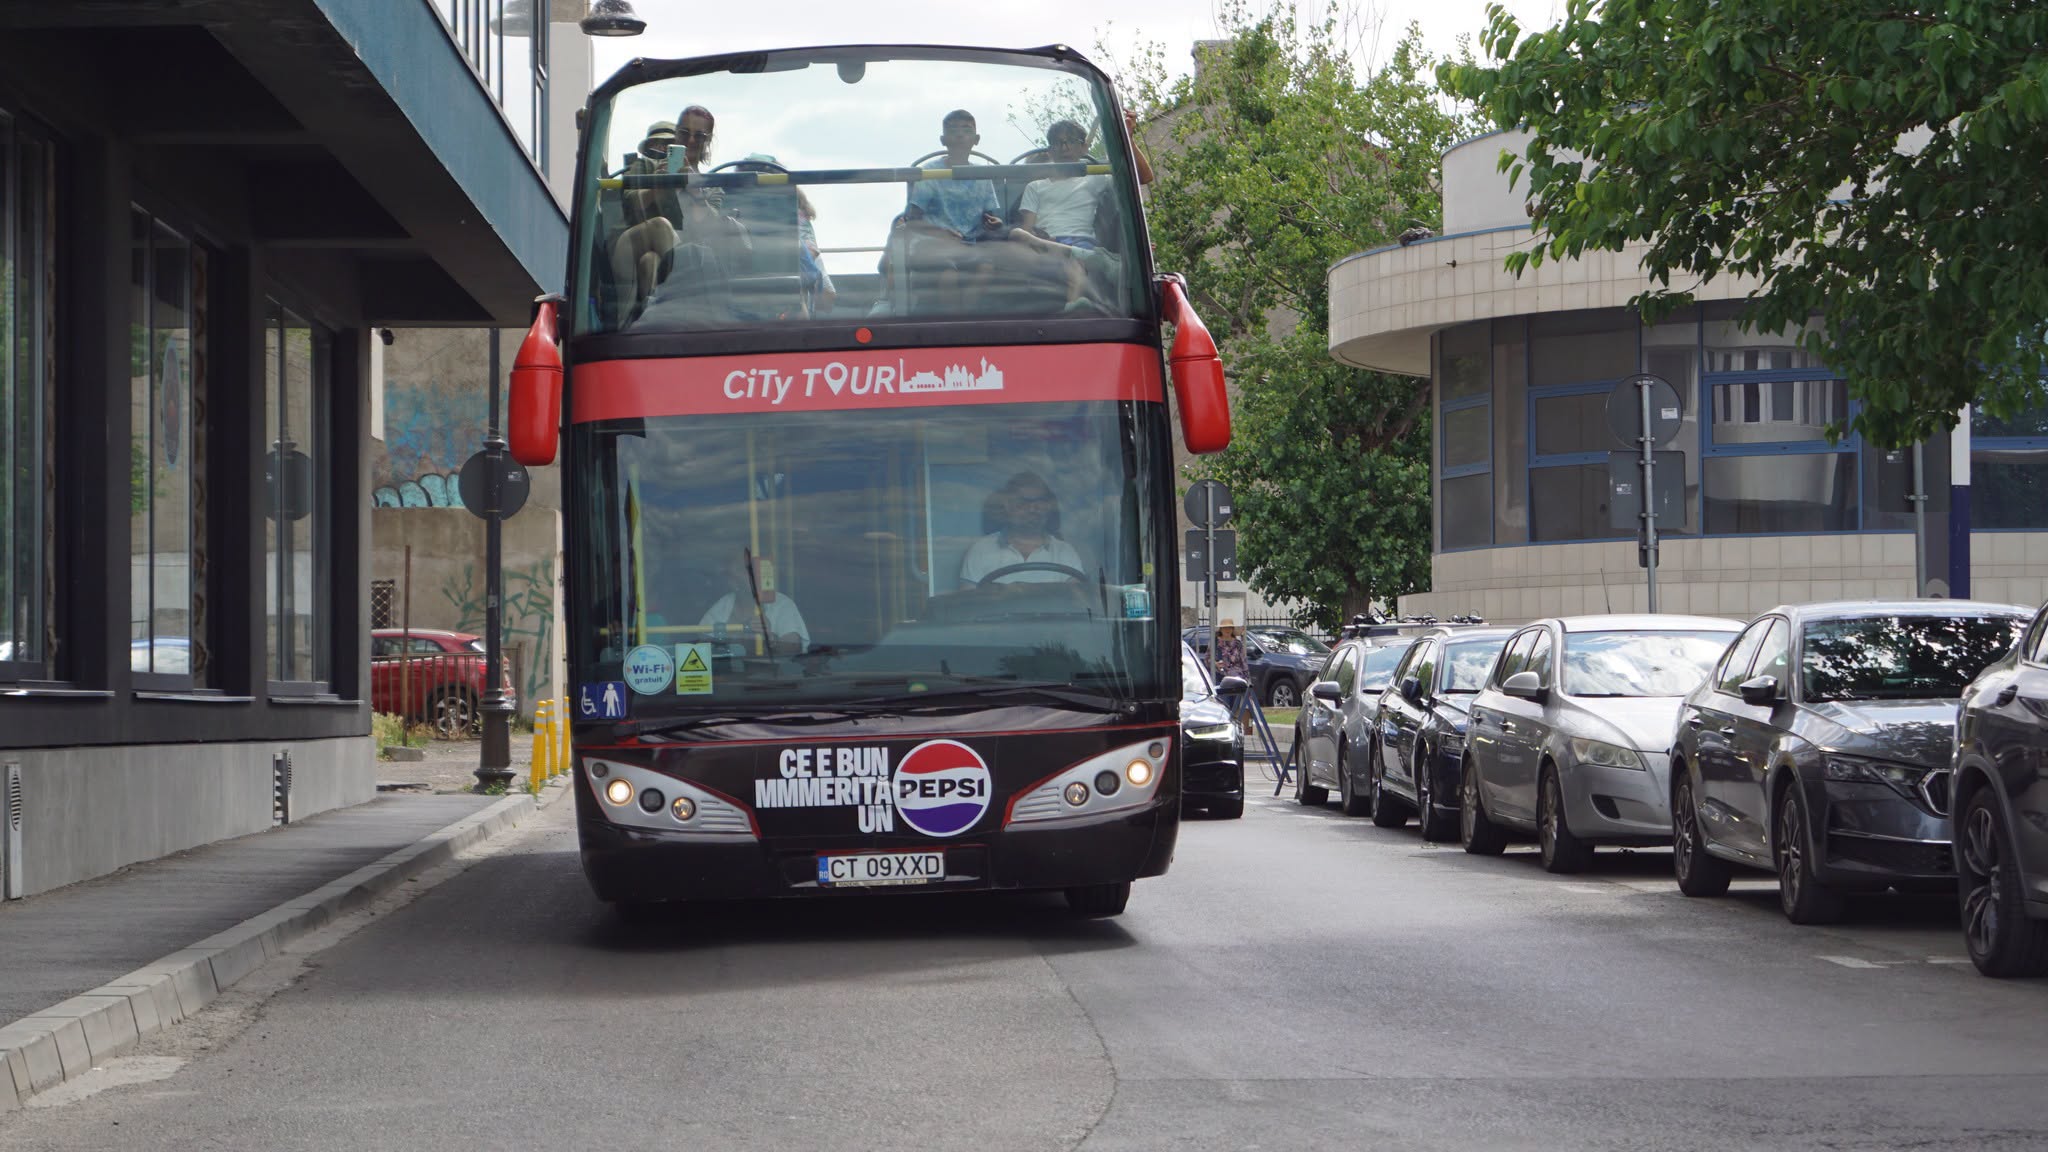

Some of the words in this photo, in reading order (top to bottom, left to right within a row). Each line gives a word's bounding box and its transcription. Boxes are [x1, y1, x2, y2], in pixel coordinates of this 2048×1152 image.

[802, 362, 896, 397] TOUR
[632, 664, 665, 674] Wi-Fi
[634, 676, 663, 685] gratuit
[779, 748, 812, 778] CE
[816, 748, 832, 777] E
[836, 746, 889, 776] BUN
[755, 775, 893, 808] MMMERITĂ
[900, 777, 985, 799] PEPSI
[857, 804, 894, 833] UN
[830, 858, 858, 879] CT
